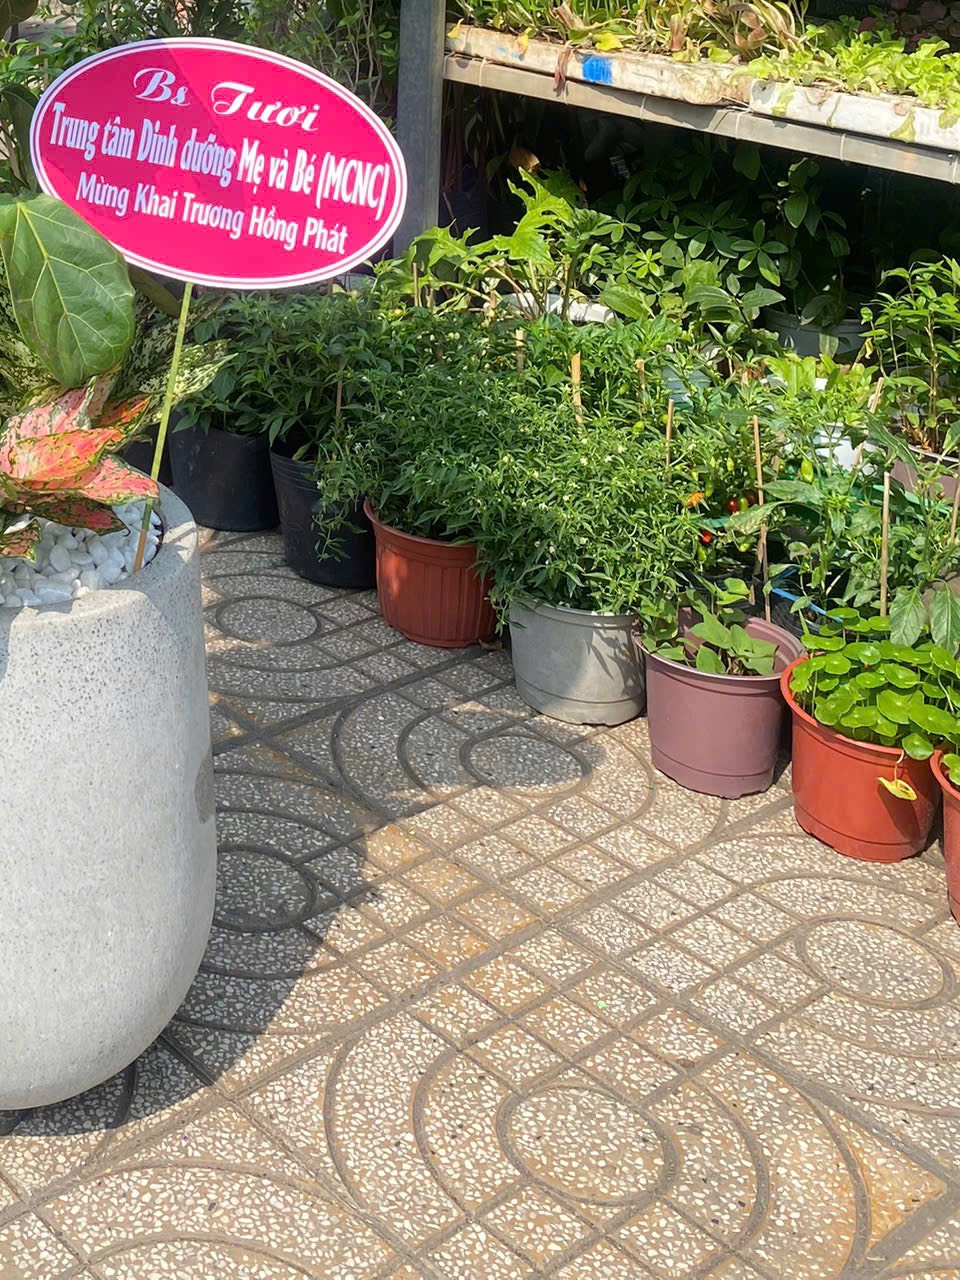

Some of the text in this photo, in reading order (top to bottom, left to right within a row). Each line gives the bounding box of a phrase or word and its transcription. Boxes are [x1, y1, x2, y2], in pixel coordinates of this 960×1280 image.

[133, 67, 321, 132] Bs Tươi
[50, 101, 101, 161] Trung
[101, 116, 136, 160] tâm
[136, 118, 179, 168] Dinh
[236, 138, 265, 195] Mẹ
[268, 148, 290, 190] và
[290, 148, 317, 195] Bé
[316, 151, 391, 221] (MCNC)
[75, 171, 130, 217] Mừng
[133, 182, 179, 220] Khai
[248, 205, 299, 252] Hồng
[302, 216, 348, 255] Phát
